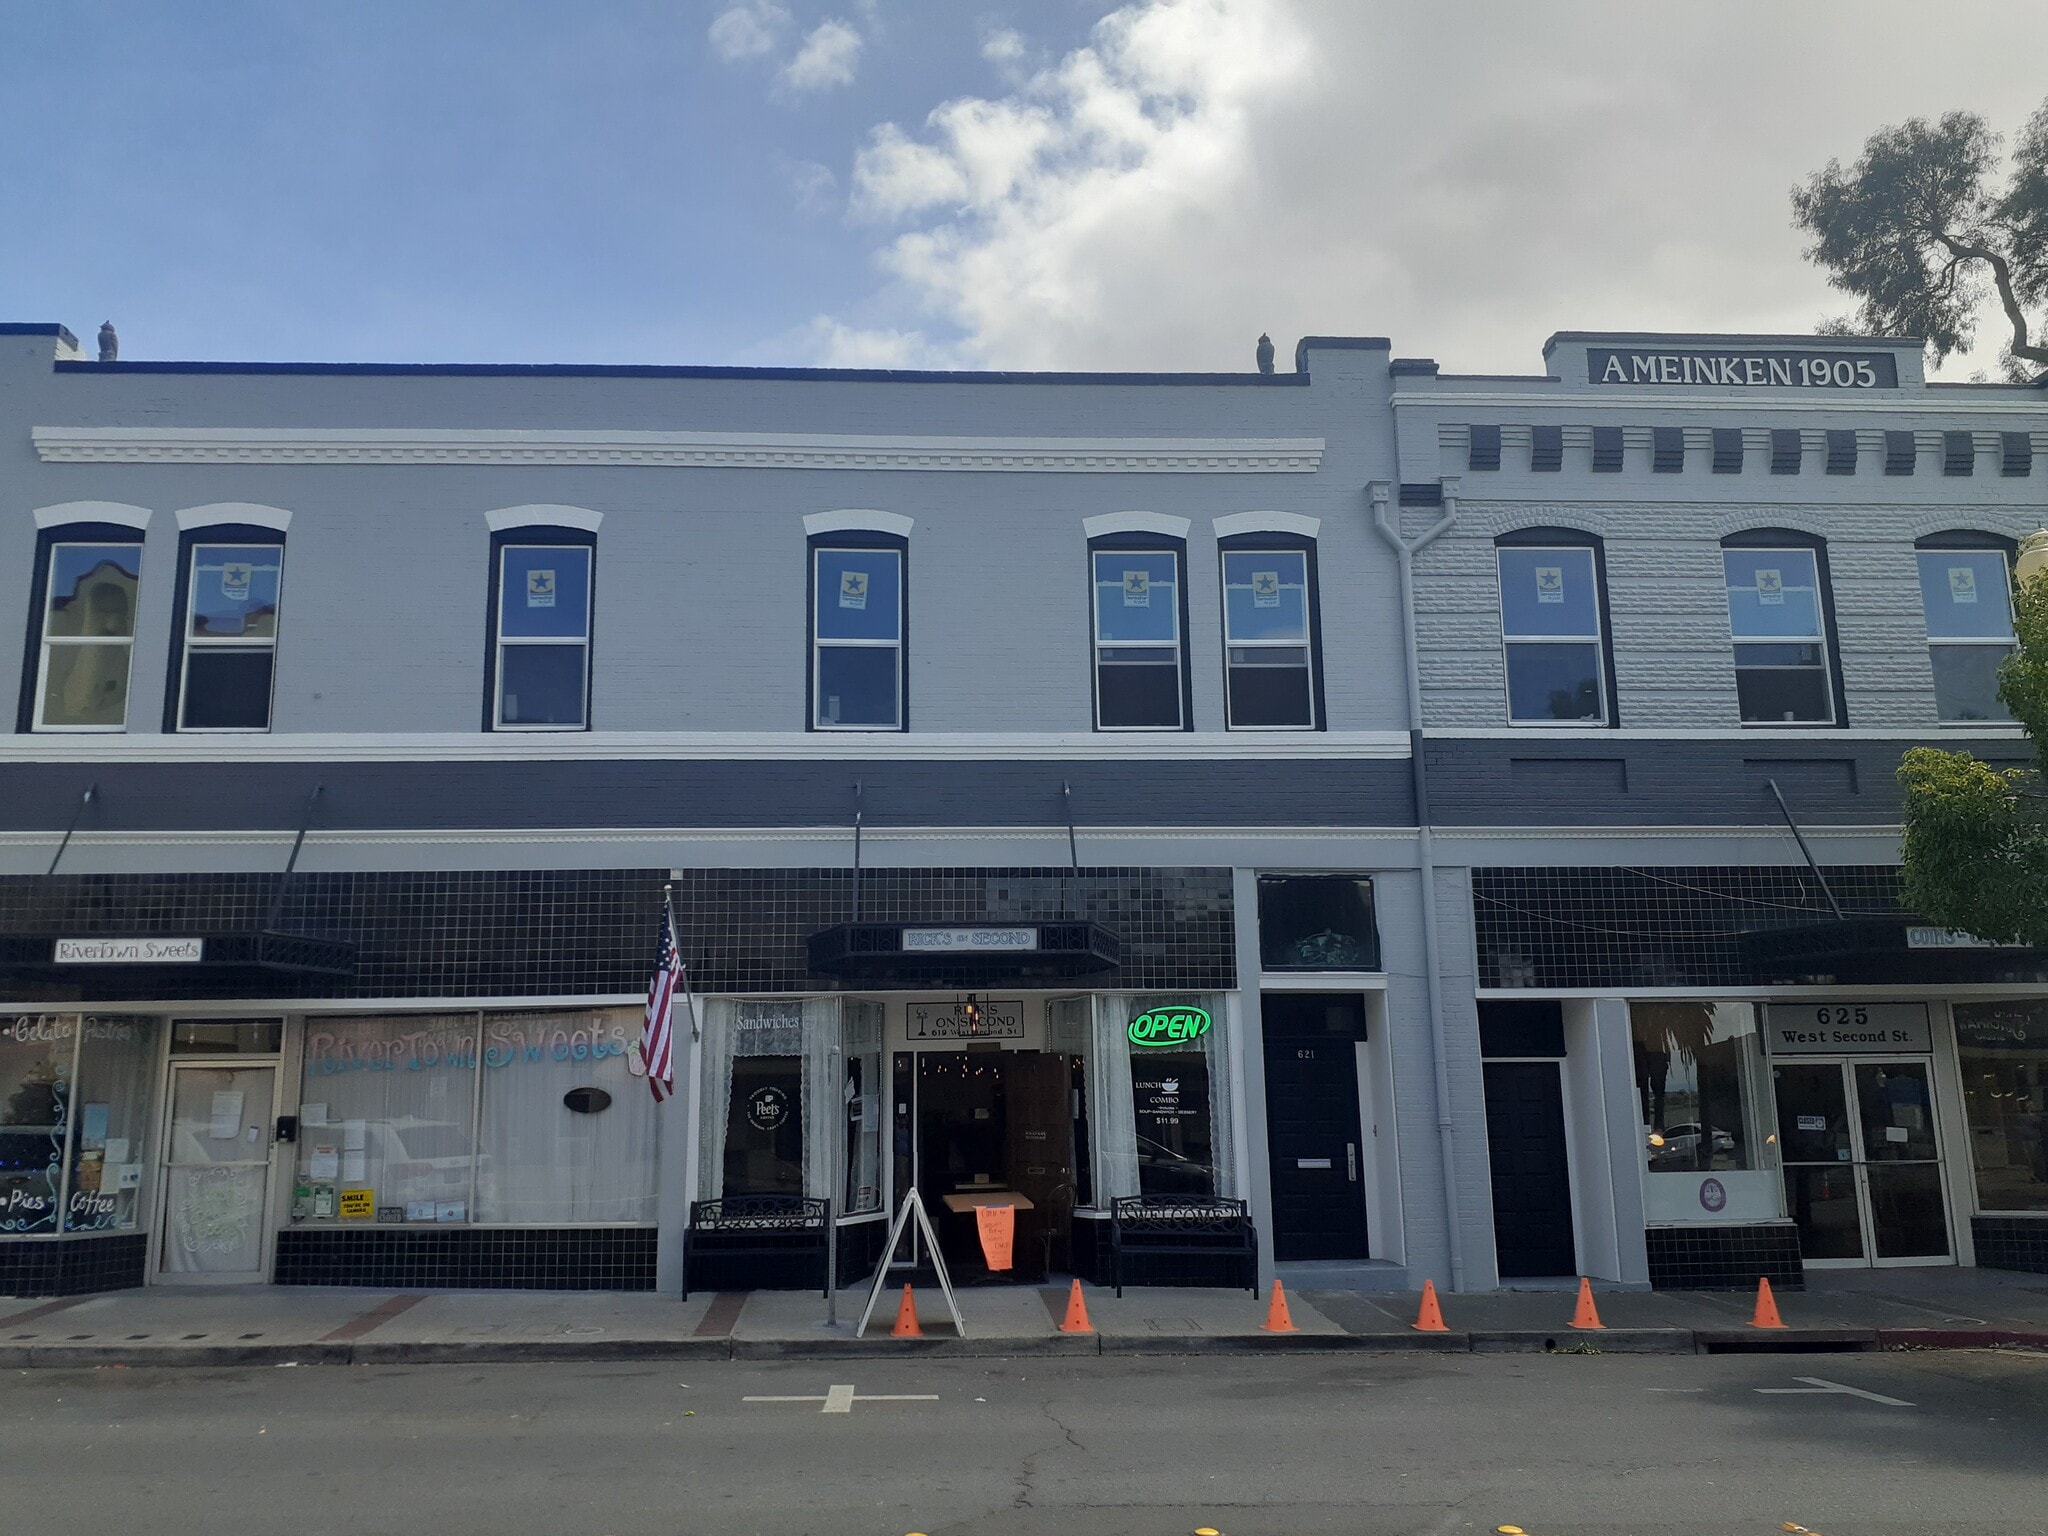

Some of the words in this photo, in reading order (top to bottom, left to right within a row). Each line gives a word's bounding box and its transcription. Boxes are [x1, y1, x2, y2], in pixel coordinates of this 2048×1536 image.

[1602, 355, 1628, 382] A
[1631, 355, 1793, 385] MEINKEN
[1798, 358, 1877, 387] 1905
[908, 931, 952, 946] RICK'S
[971, 931, 1030, 945] SECOND
[1910, 928, 1957, 945] COINS
[60, 942, 138, 959] RiverTown
[143, 942, 199, 958] Sweets
[954, 1005, 998, 1015] RIKS
[1816, 1007, 1868, 1024] 625
[15, 1015, 72, 1041] Gelato
[737, 1014, 799, 1030] Sandwiches
[936, 1018, 956, 1027] ON
[961, 1016, 1015, 1026] SCOND
[1133, 1014, 1201, 1038] OPEN
[485, 1018, 628, 1068] Sweets
[1782, 1030, 1827, 1042] West
[1832, 1030, 1886, 1042] Second
[1892, 1030, 1913, 1042] St.
[1297, 1050, 1314, 1059] 621
[1149, 1096, 1179, 1104] COMBO
[8, 1188, 45, 1213] Pies
[70, 1190, 115, 1216] Coffee
[341, 1193, 364, 1202] SMILE
